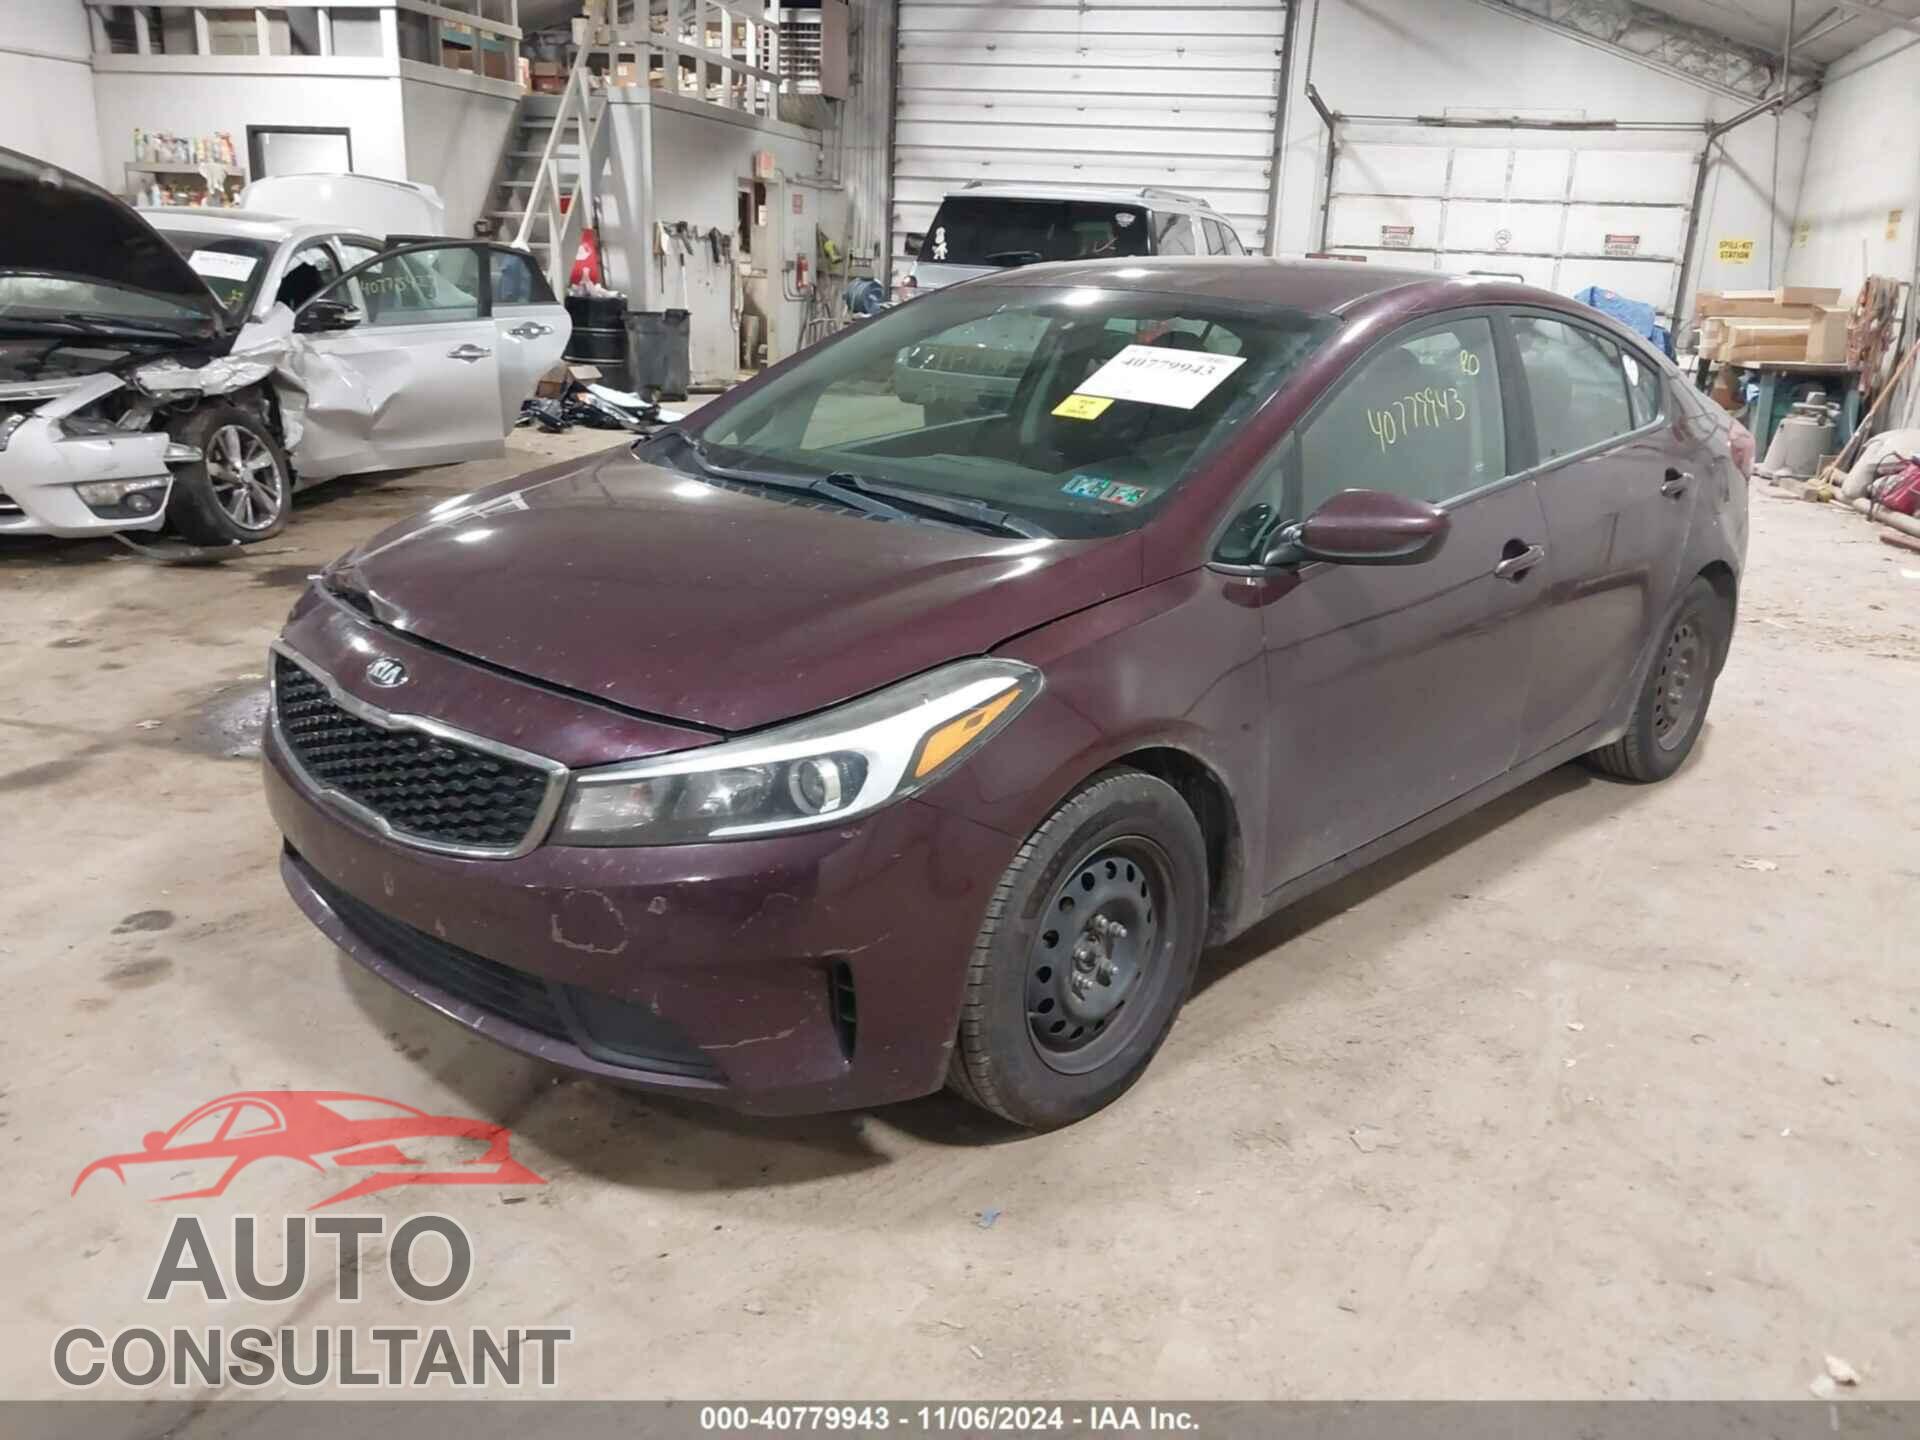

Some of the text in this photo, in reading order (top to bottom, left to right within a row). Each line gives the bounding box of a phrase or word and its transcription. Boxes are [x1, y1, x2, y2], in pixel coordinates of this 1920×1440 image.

[1719, 250, 1750, 259] STATION
[1121, 356, 1217, 377] 40779943
[1366, 386, 1466, 453] 40779943
[368, 660, 403, 685] KIA
